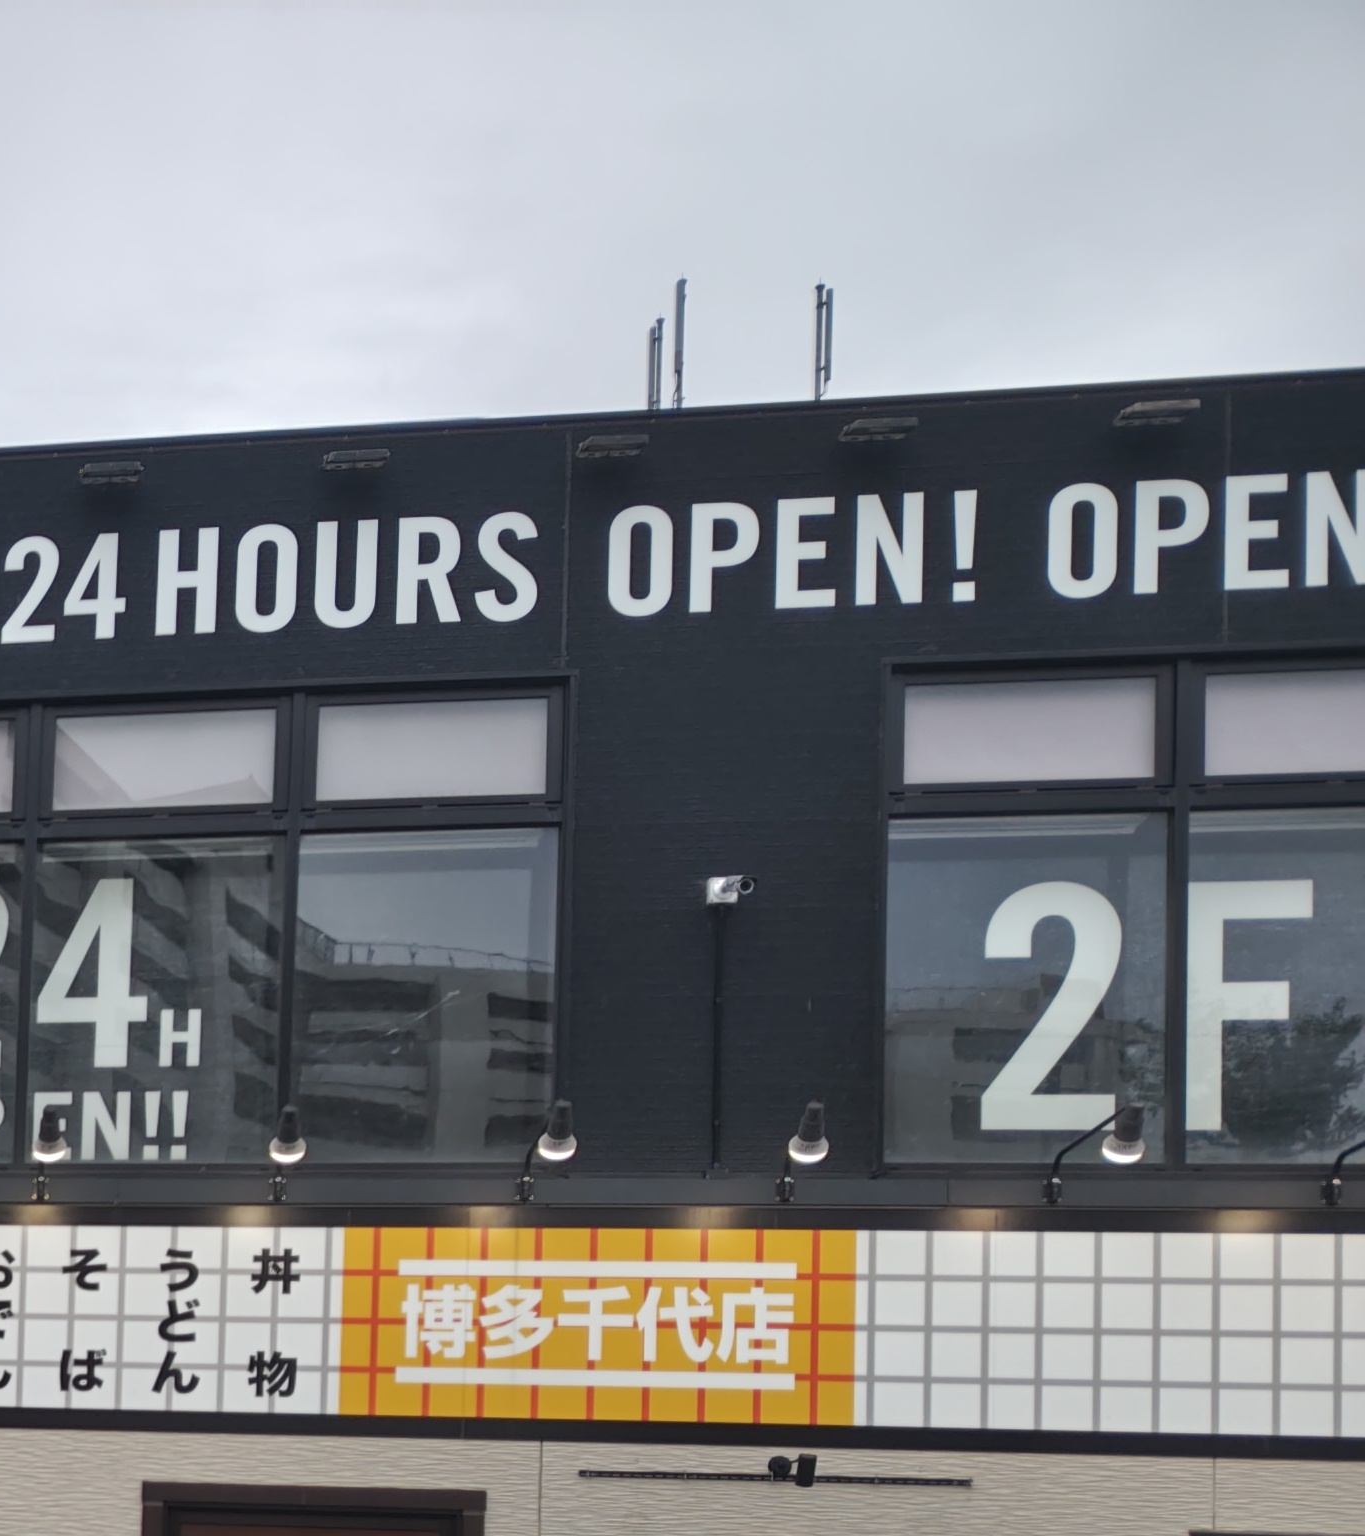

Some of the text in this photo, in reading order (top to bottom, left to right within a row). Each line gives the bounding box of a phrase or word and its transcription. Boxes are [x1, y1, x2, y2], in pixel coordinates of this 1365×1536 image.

[0, 469, 1365, 645] 24 HOURS OPEN! OPEN
[980, 879, 1314, 1131] 2F
[59, 1249, 108, 1392] そば
[152, 1249, 200, 1395] うどん
[247, 1249, 300, 1397] 丼物
[401, 1285, 795, 1366] 博多千代店
